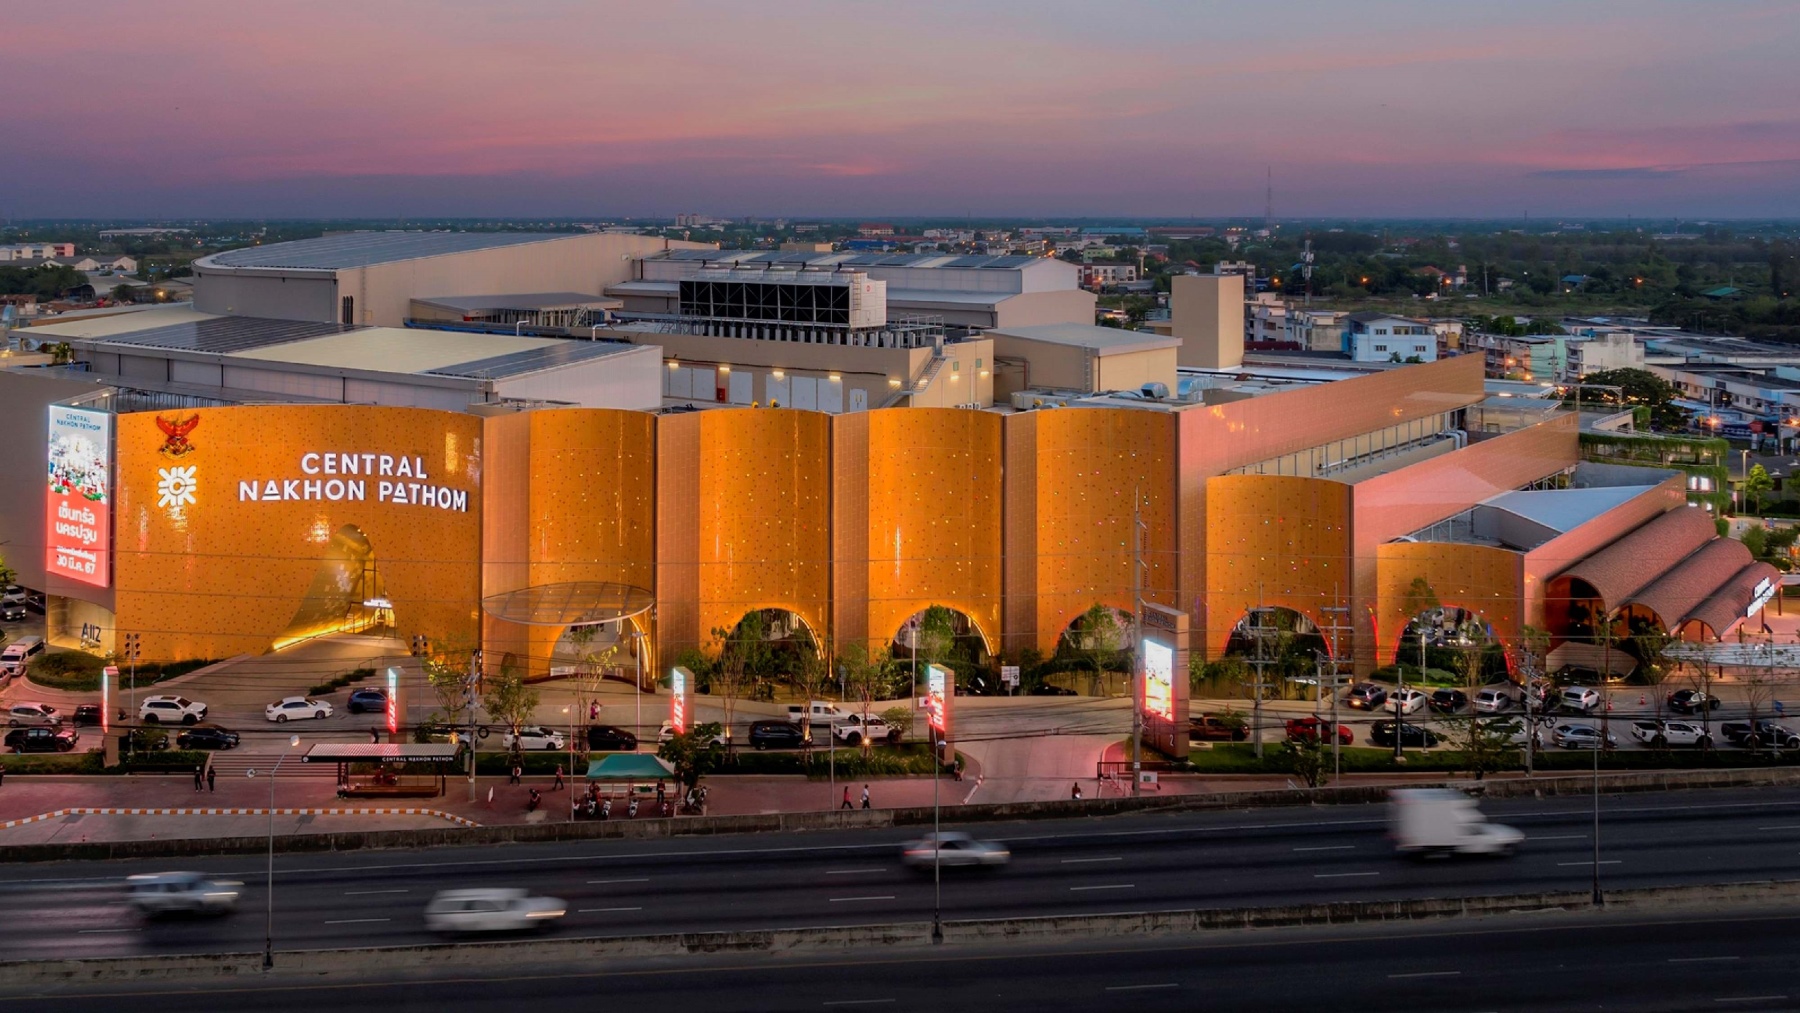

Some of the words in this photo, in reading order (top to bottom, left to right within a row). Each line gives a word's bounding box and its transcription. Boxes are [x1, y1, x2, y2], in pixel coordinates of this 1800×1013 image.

[66, 413, 91, 424] CENTRAL
[301, 453, 428, 479] CENTRAL
[239, 479, 365, 502] NAKHON
[379, 482, 468, 512] PATHOM
